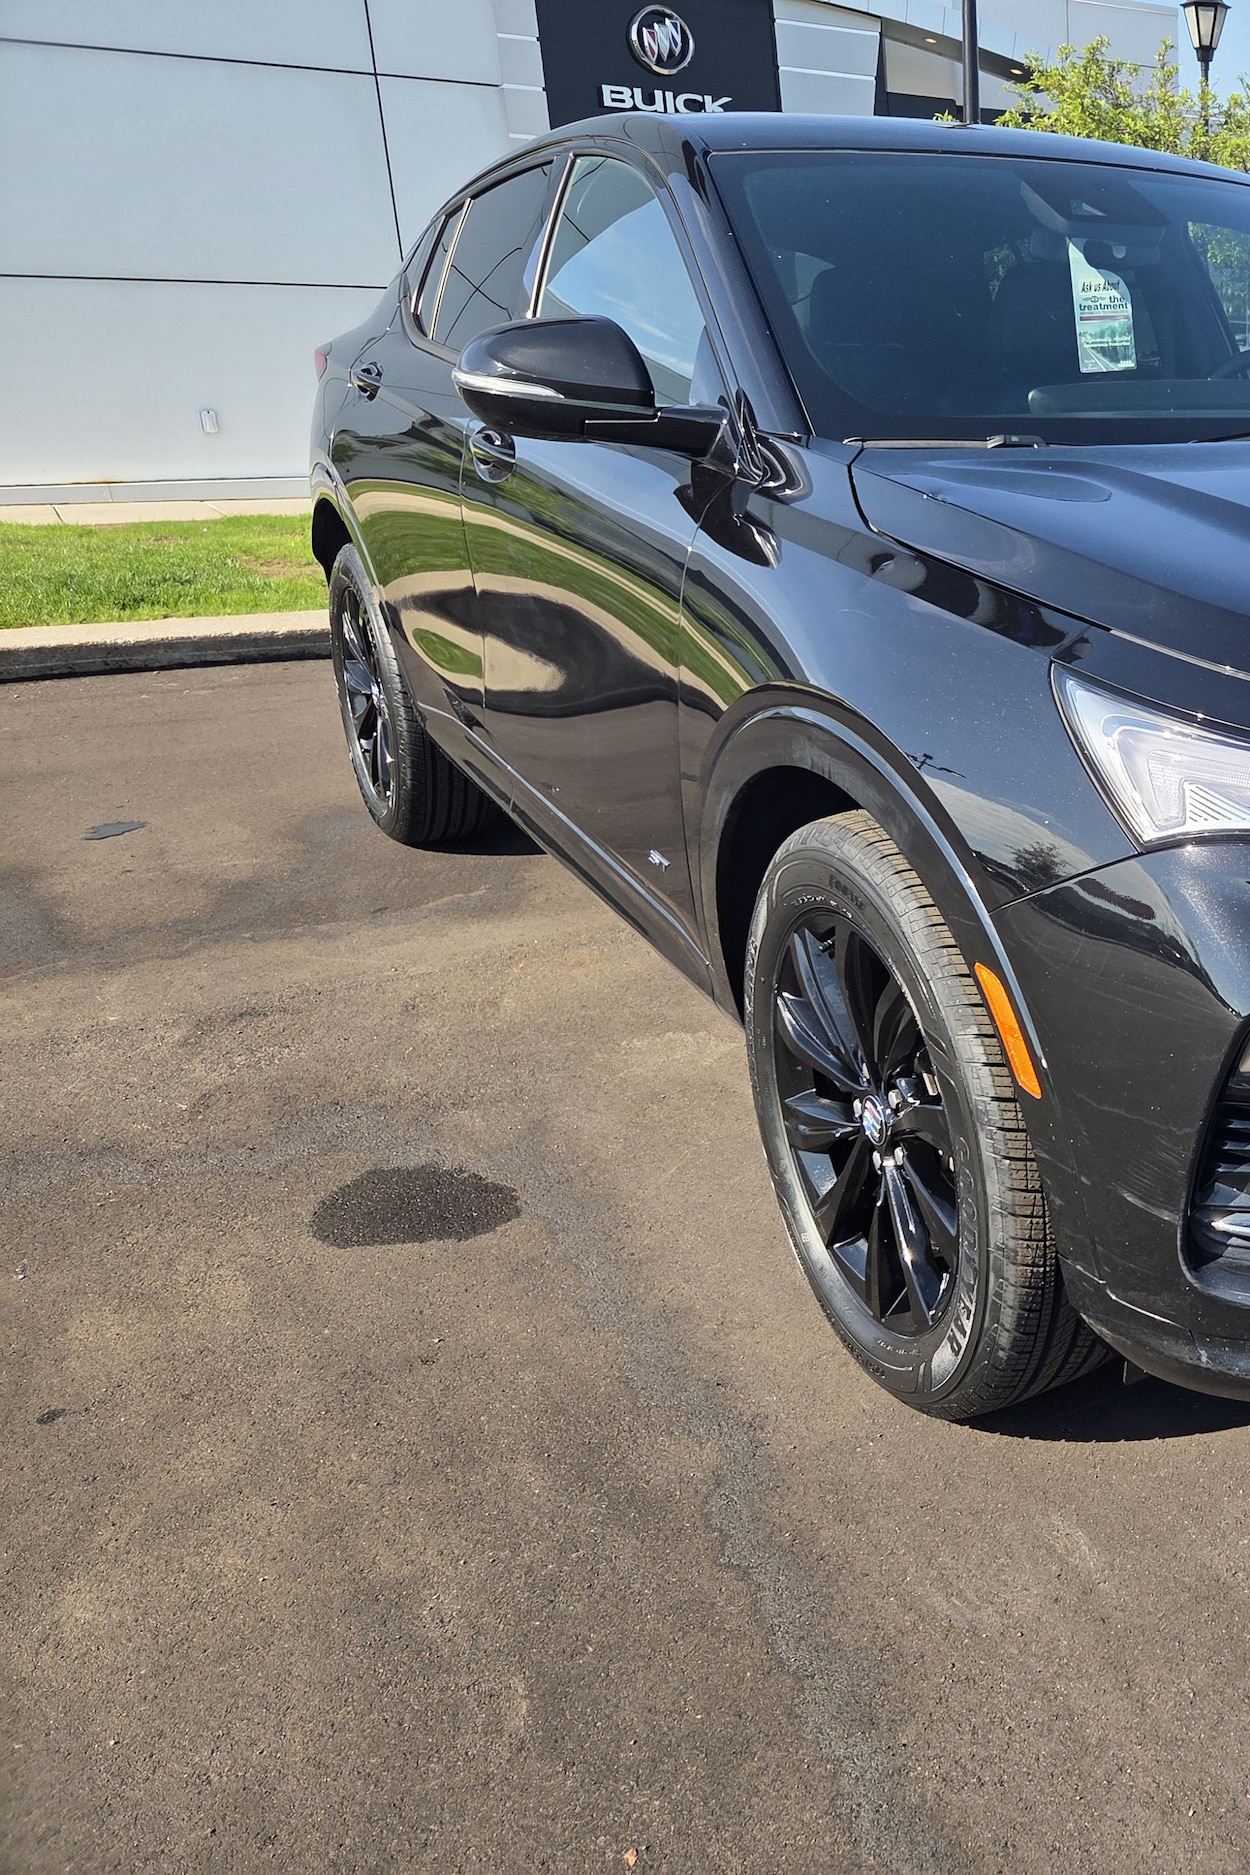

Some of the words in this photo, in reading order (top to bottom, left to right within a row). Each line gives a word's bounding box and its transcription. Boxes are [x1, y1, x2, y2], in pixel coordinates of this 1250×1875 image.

[601, 84, 733, 114] BUICK
[1081, 281, 1092, 293] Ask
[1109, 295, 1125, 303] the
[1079, 302, 1128, 311] treatment
